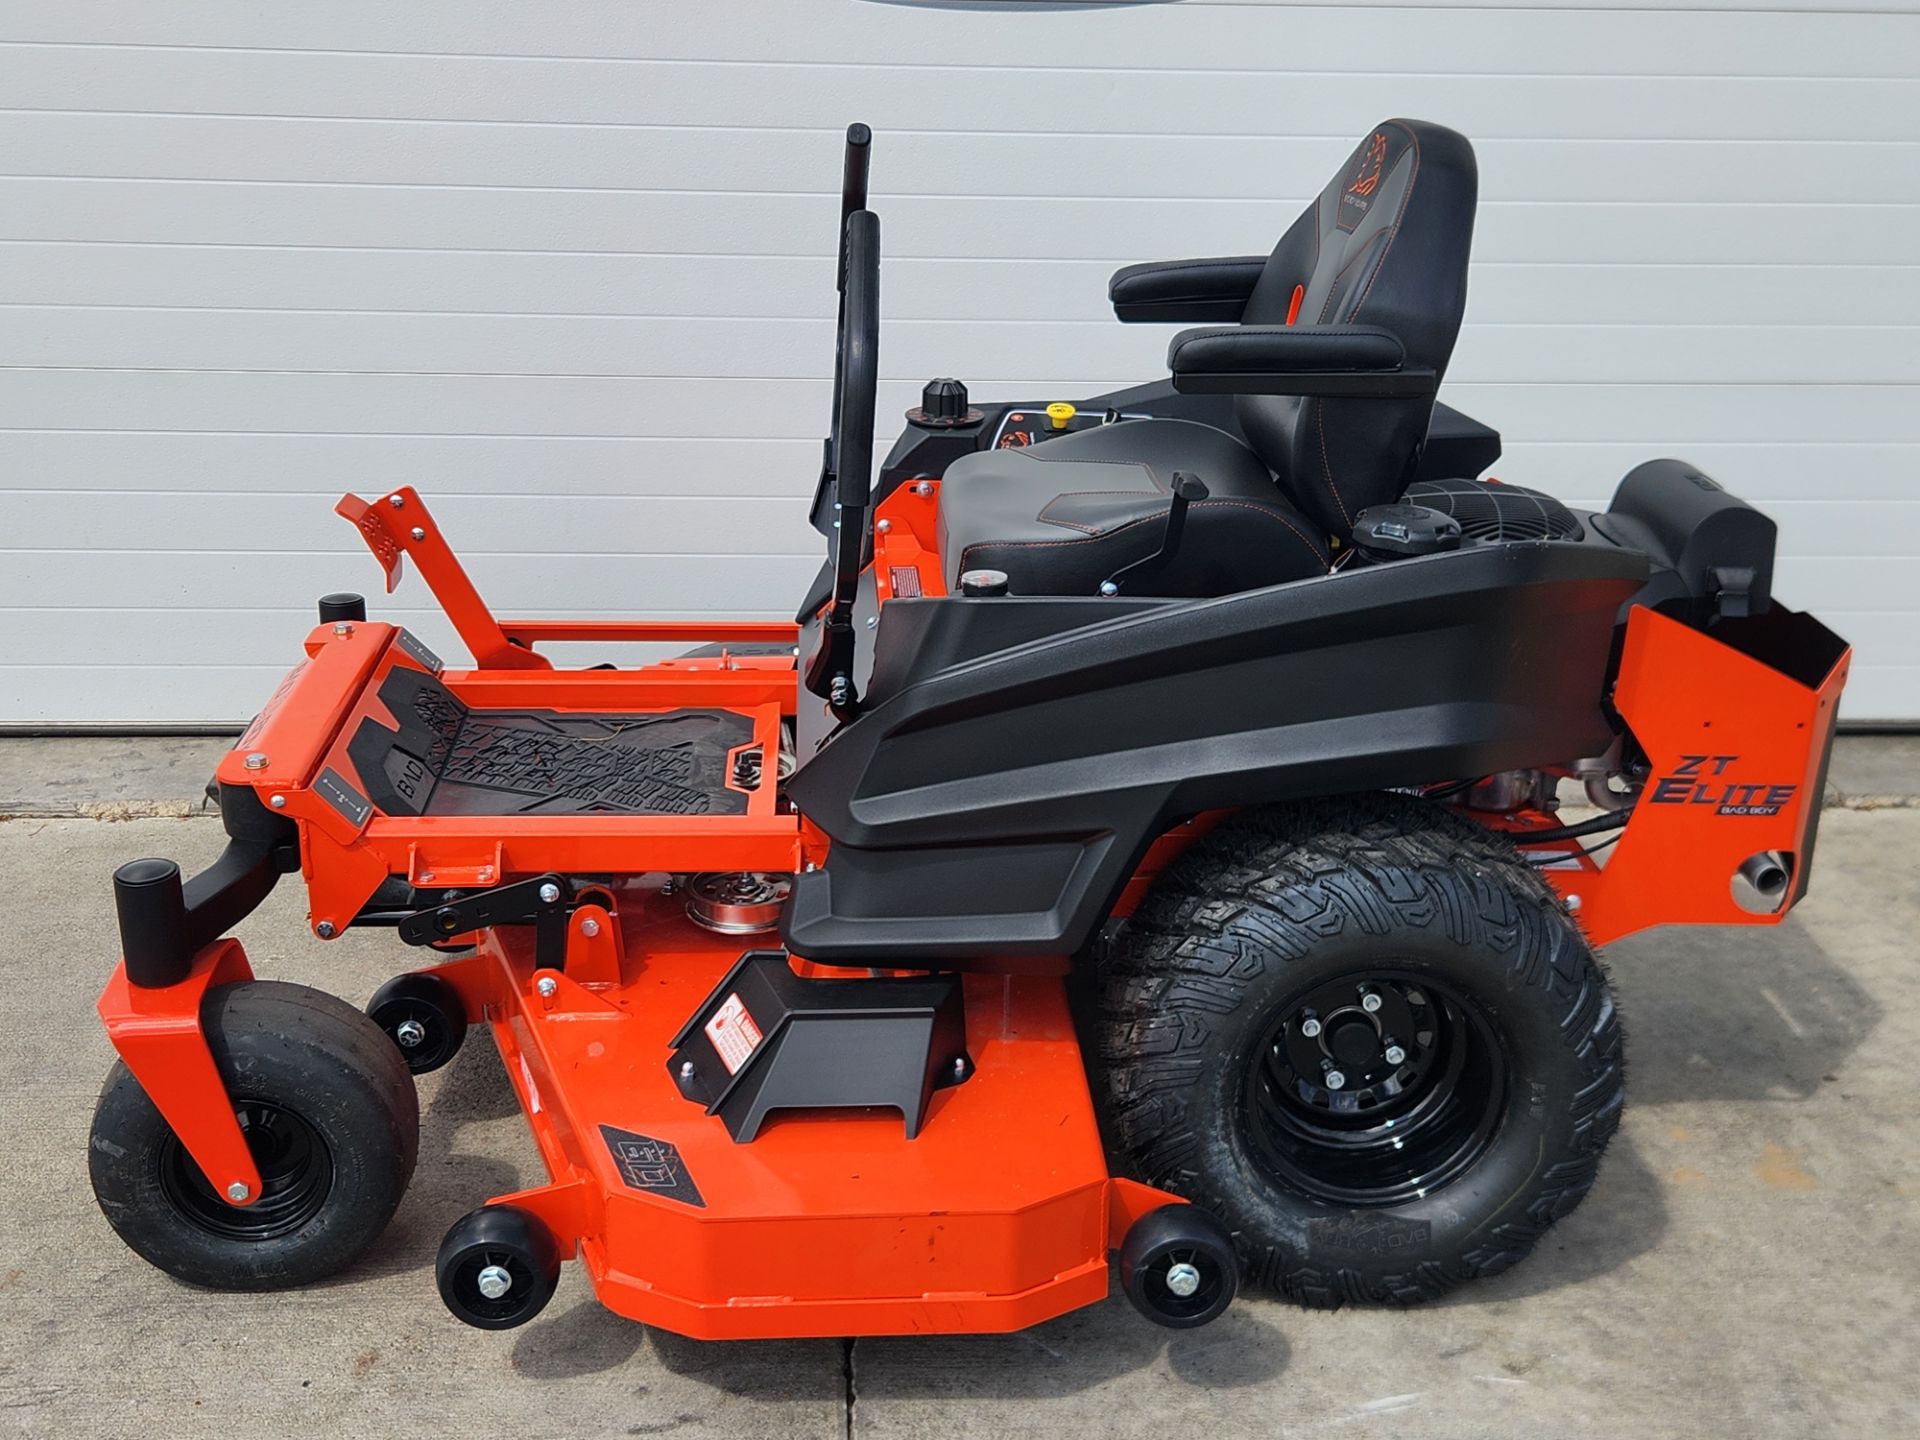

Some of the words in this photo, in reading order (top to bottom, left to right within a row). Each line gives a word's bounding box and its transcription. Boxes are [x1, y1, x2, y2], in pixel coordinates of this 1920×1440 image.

[1673, 755, 1739, 776] ZT
[396, 760, 424, 799] BAD
[1649, 778, 1798, 805] ELITE
[1721, 807, 1748, 815] BAD
[1749, 807, 1776, 815] BOY
